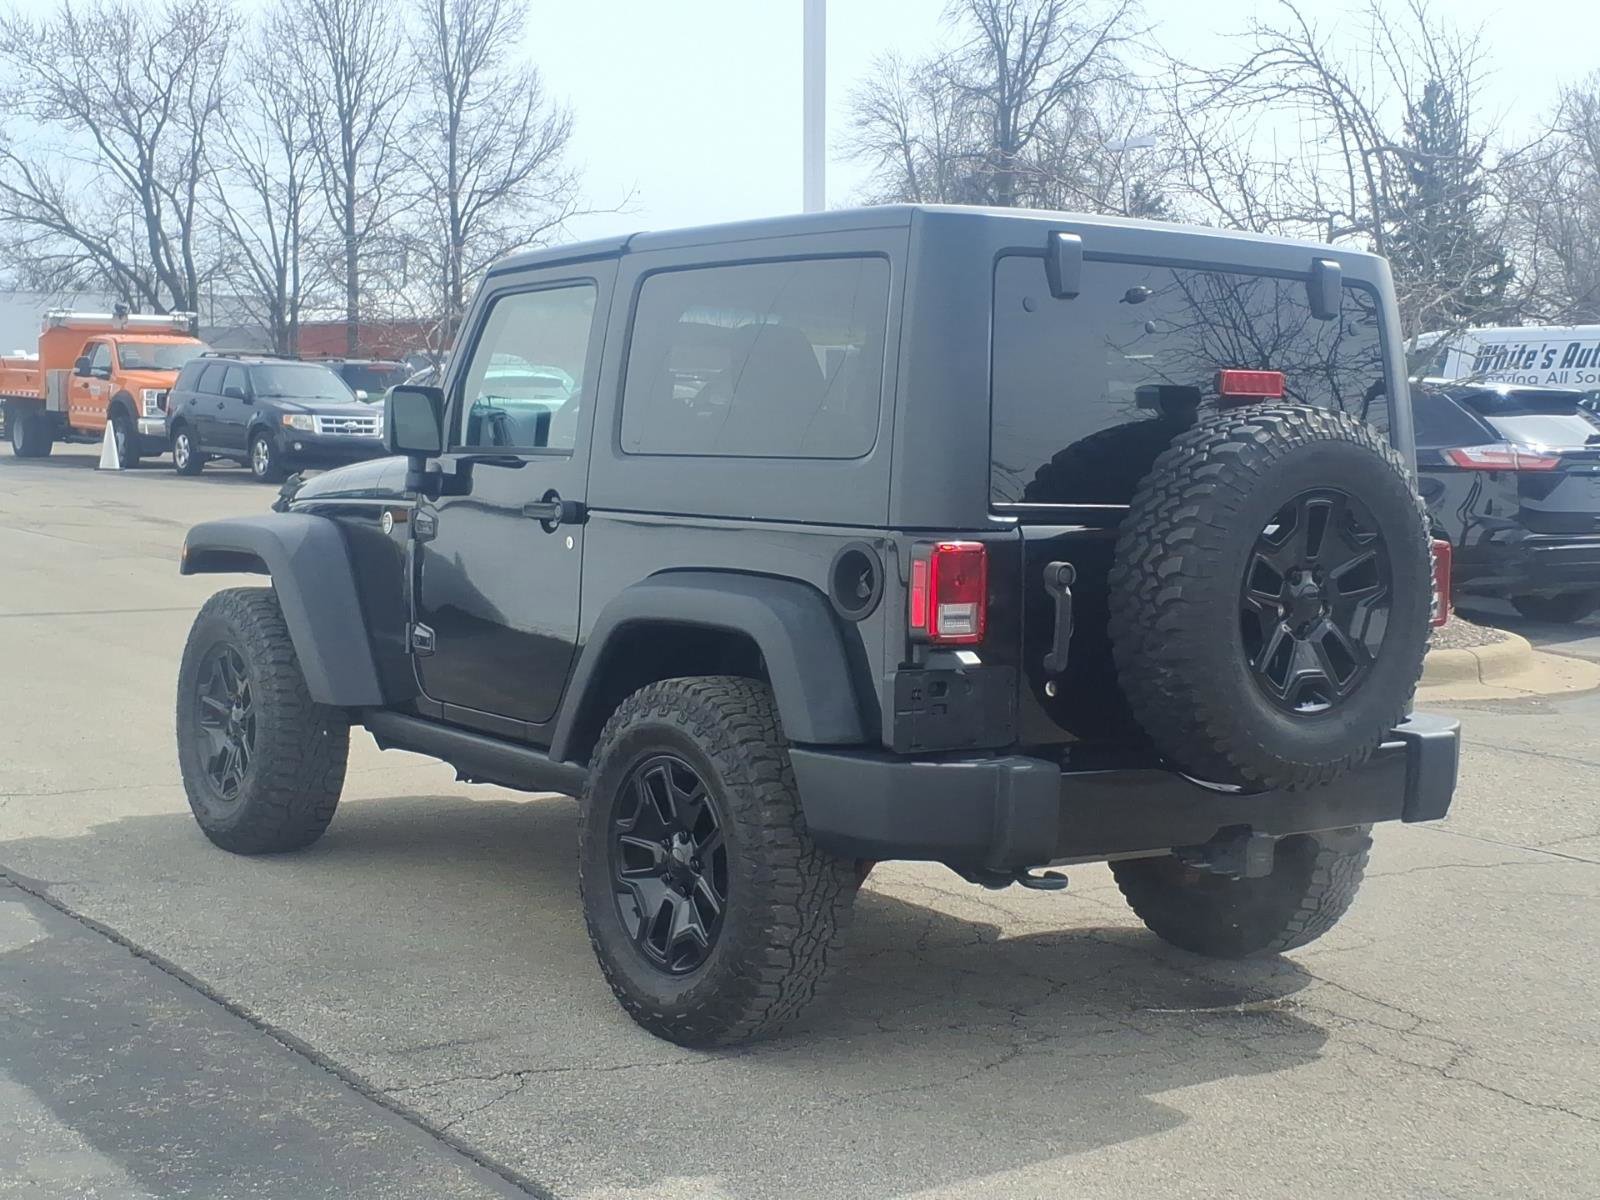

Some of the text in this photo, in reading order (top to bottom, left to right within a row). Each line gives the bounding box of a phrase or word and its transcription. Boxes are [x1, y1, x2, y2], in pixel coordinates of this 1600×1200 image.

[1472, 342, 1600, 371] White's Aut
[1545, 371, 1568, 384] All
[1574, 370, 1600, 384] So
